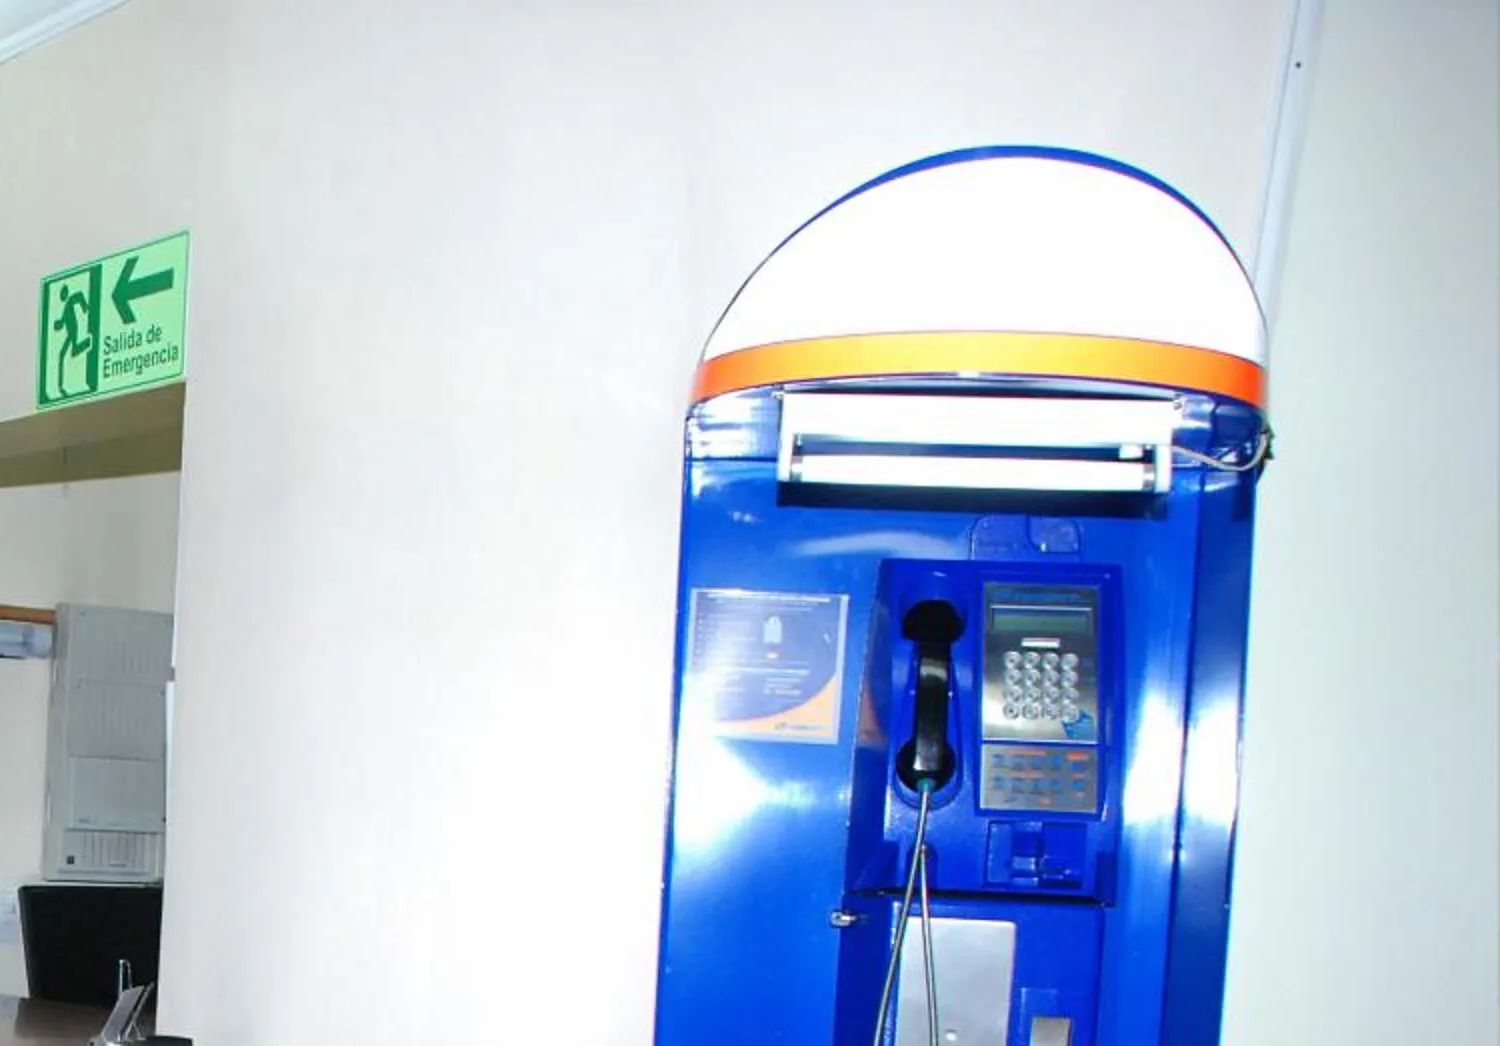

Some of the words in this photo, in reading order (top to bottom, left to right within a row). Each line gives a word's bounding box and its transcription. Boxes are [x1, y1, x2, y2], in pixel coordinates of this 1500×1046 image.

[102, 330, 143, 355] Salida
[145, 323, 162, 344] de
[103, 343, 179, 378] Emergencia
